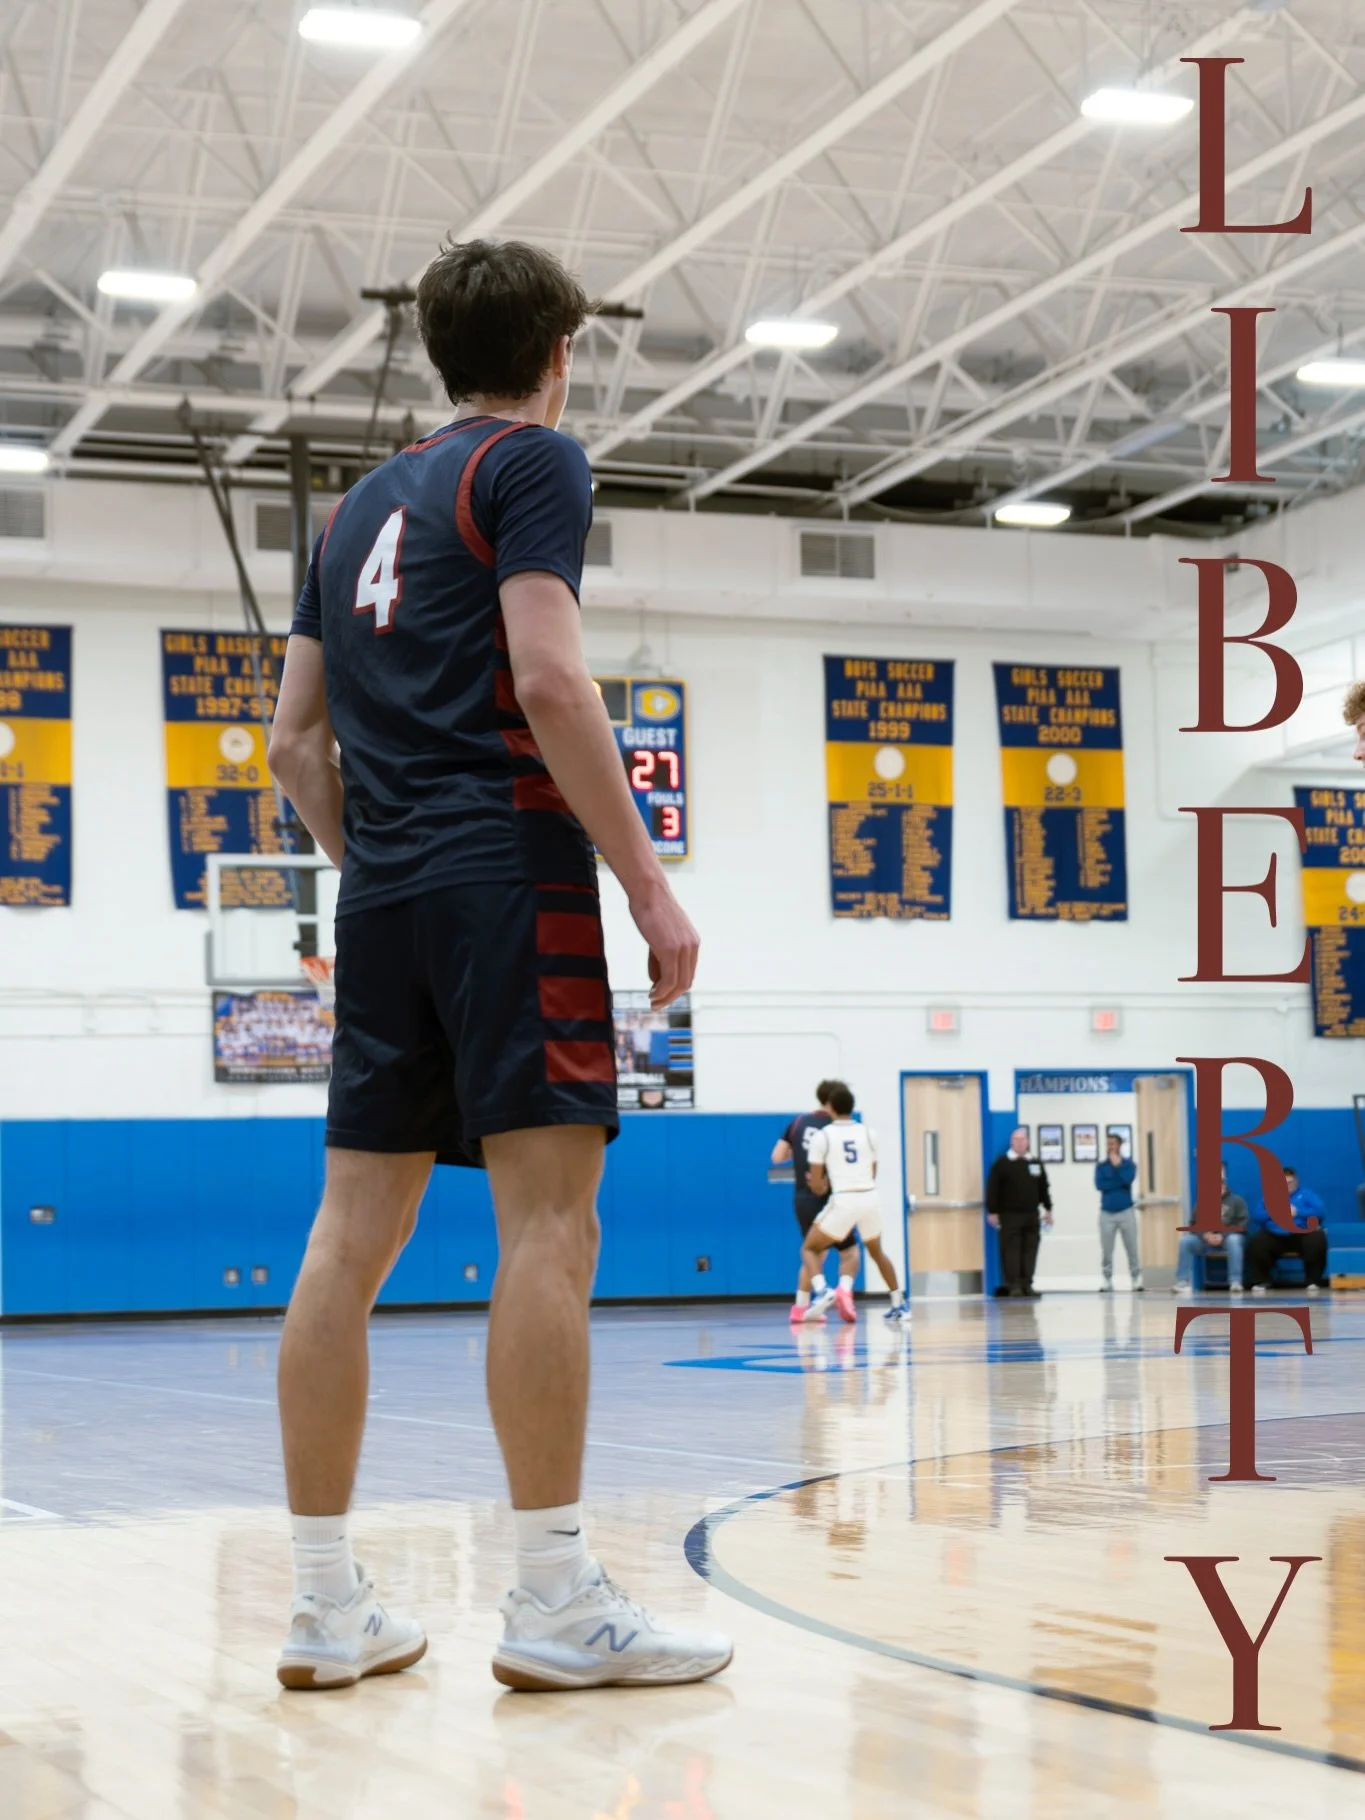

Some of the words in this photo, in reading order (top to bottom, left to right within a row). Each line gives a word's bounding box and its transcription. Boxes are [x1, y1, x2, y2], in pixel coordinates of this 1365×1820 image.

[352, 505, 407, 636] 4
[844, 659, 877, 679] BOYS
[887, 662, 935, 681] SOCCER
[1011, 667, 1048, 686] GIRLS
[1057, 670, 1103, 688] SOCCER
[169, 674, 213, 697] STATE
[856, 680, 887, 698] PIAA
[896, 682, 923, 699] AAA
[1027, 687, 1056, 704] PIAA
[1066, 689, 1090, 706] AAA
[831, 700, 868, 718] STATE
[879, 702, 947, 721] CHAMPIONS
[1002, 705, 1039, 725] STATE
[1050, 707, 1115, 726] CHAMPIONS
[622, 727, 678, 748] GUEST
[868, 720, 911, 739] 1999
[1038, 725, 1082, 744] 2000
[631, 750, 681, 791] 27
[646, 791, 685, 807] FOULS
[661, 806, 681, 839] 3
[842, 1140, 859, 1164] 5
